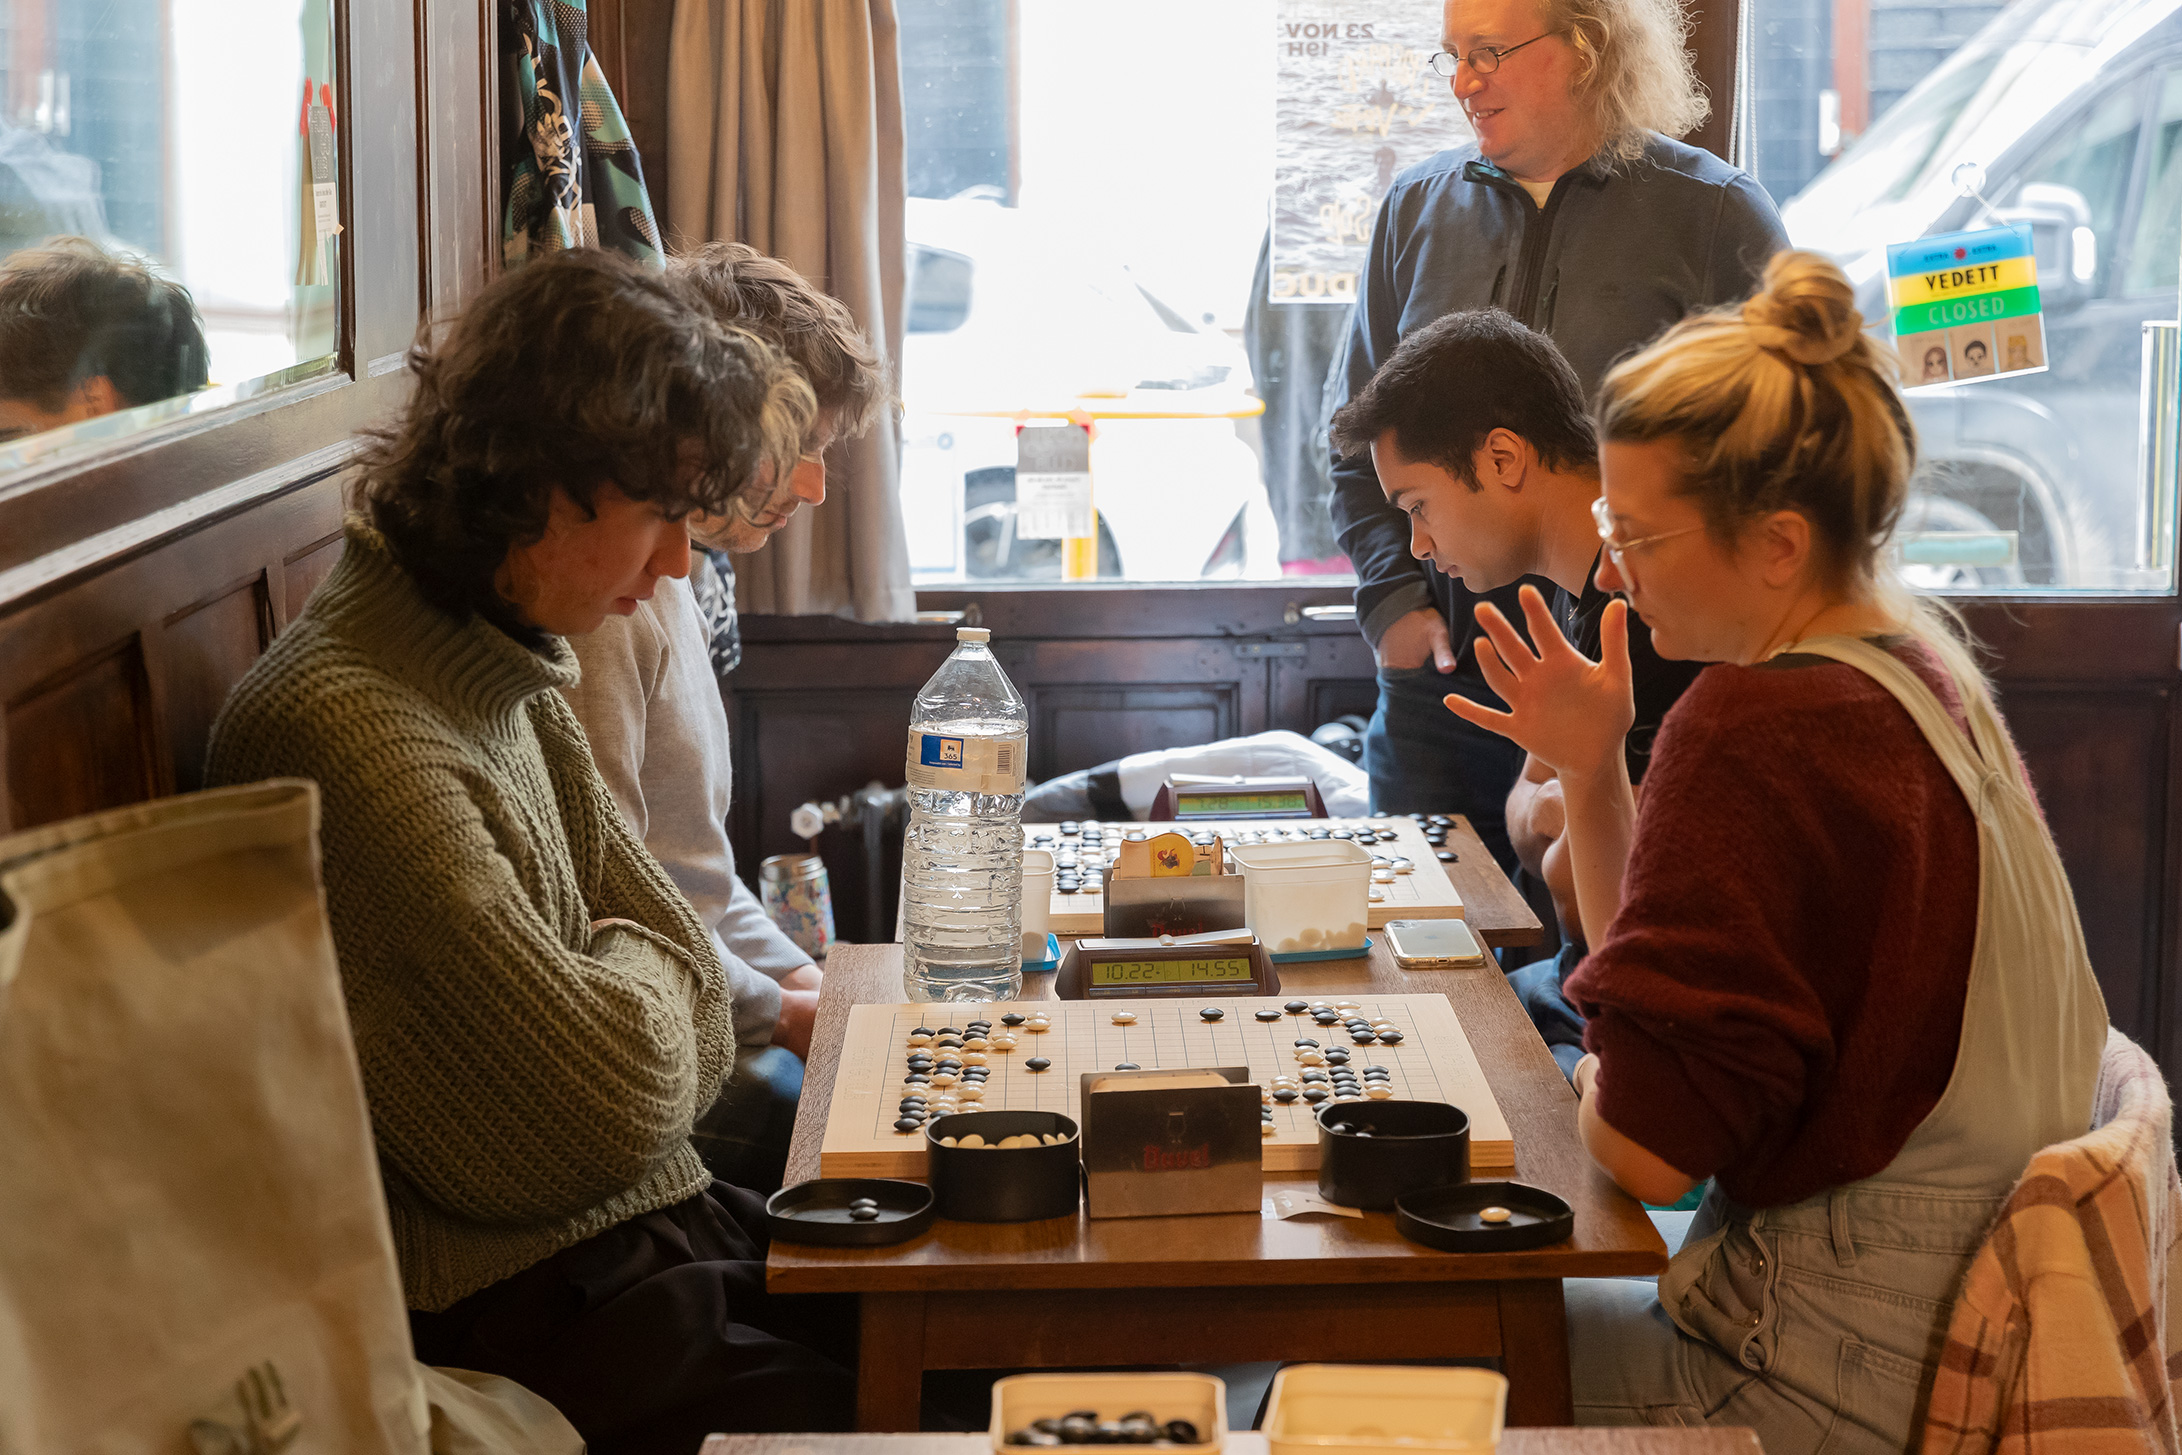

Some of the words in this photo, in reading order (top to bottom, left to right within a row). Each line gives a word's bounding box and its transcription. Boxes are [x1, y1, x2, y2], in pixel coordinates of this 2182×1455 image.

[1926, 265, 1999, 290] VEDETT
[1928, 297, 2005, 325] CLOSED
[943, 752, 958, 760] 365
[1106, 963, 1154, 980] 10.22
[1191, 960, 1240, 977] 14.55
[1143, 1142, 1211, 1172] Duvel
